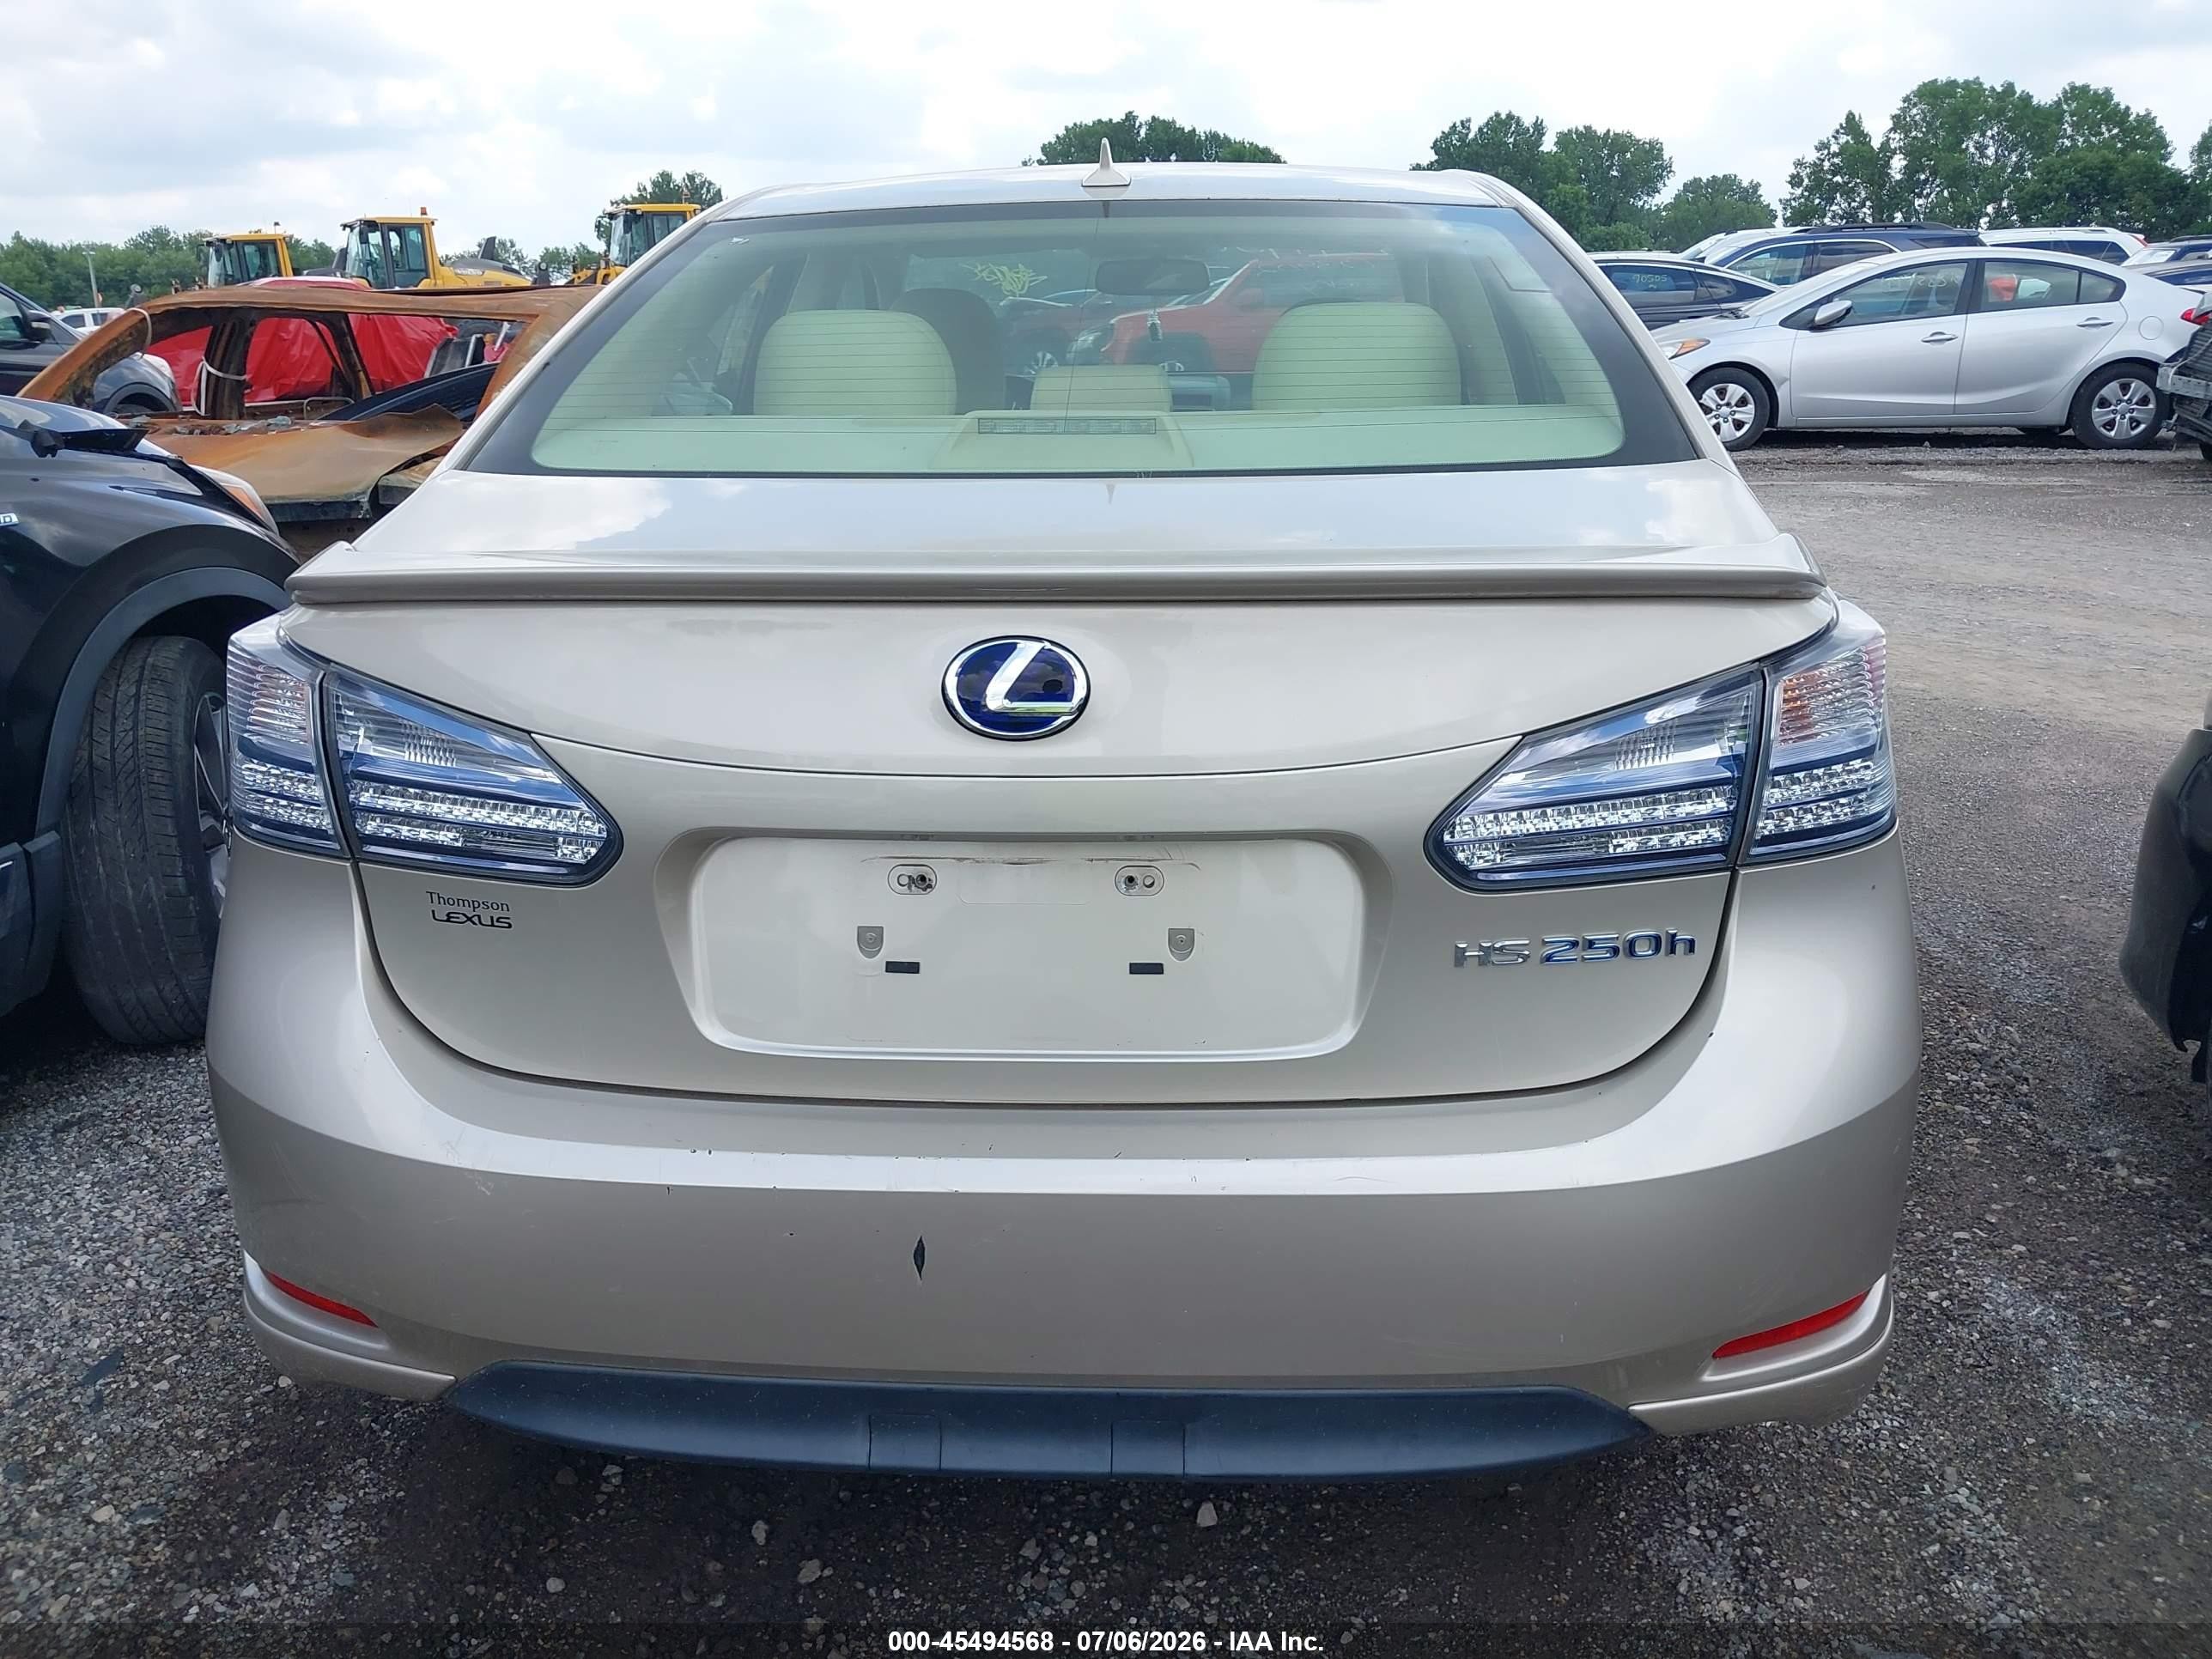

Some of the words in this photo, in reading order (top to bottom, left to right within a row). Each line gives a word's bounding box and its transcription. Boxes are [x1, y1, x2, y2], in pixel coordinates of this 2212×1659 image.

[426, 890, 510, 912] Thompson
[431, 909, 513, 929] LEXUS
[1454, 939, 1531, 968] HS
[1540, 927, 1698, 965] 250h
